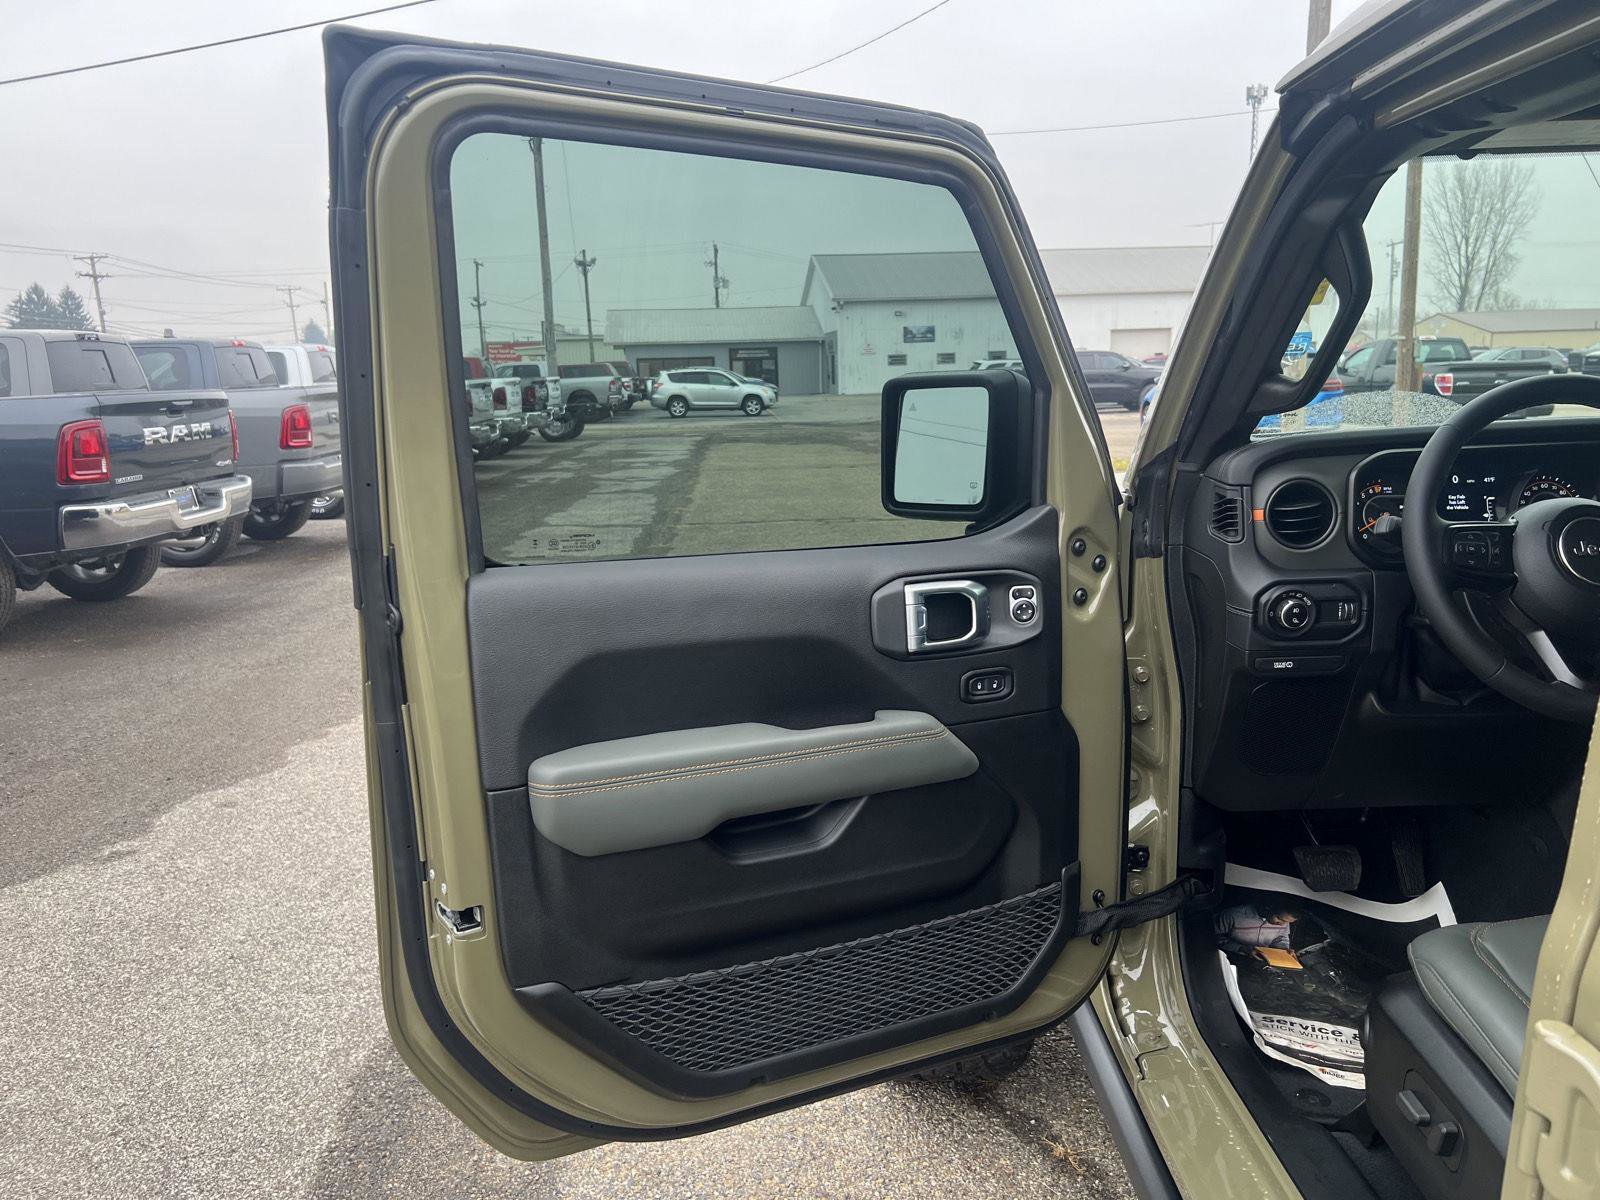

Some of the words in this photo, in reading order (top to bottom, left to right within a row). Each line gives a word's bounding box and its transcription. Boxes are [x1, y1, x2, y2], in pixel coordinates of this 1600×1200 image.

[142, 422, 212, 446] RAM
[1452, 474, 1459, 484] 0
[1573, 540, 1600, 556] Je
[1261, 1023, 1296, 1033] STICK
[1298, 1030, 1329, 1041] WITH
[1334, 1037, 1355, 1045] THE
